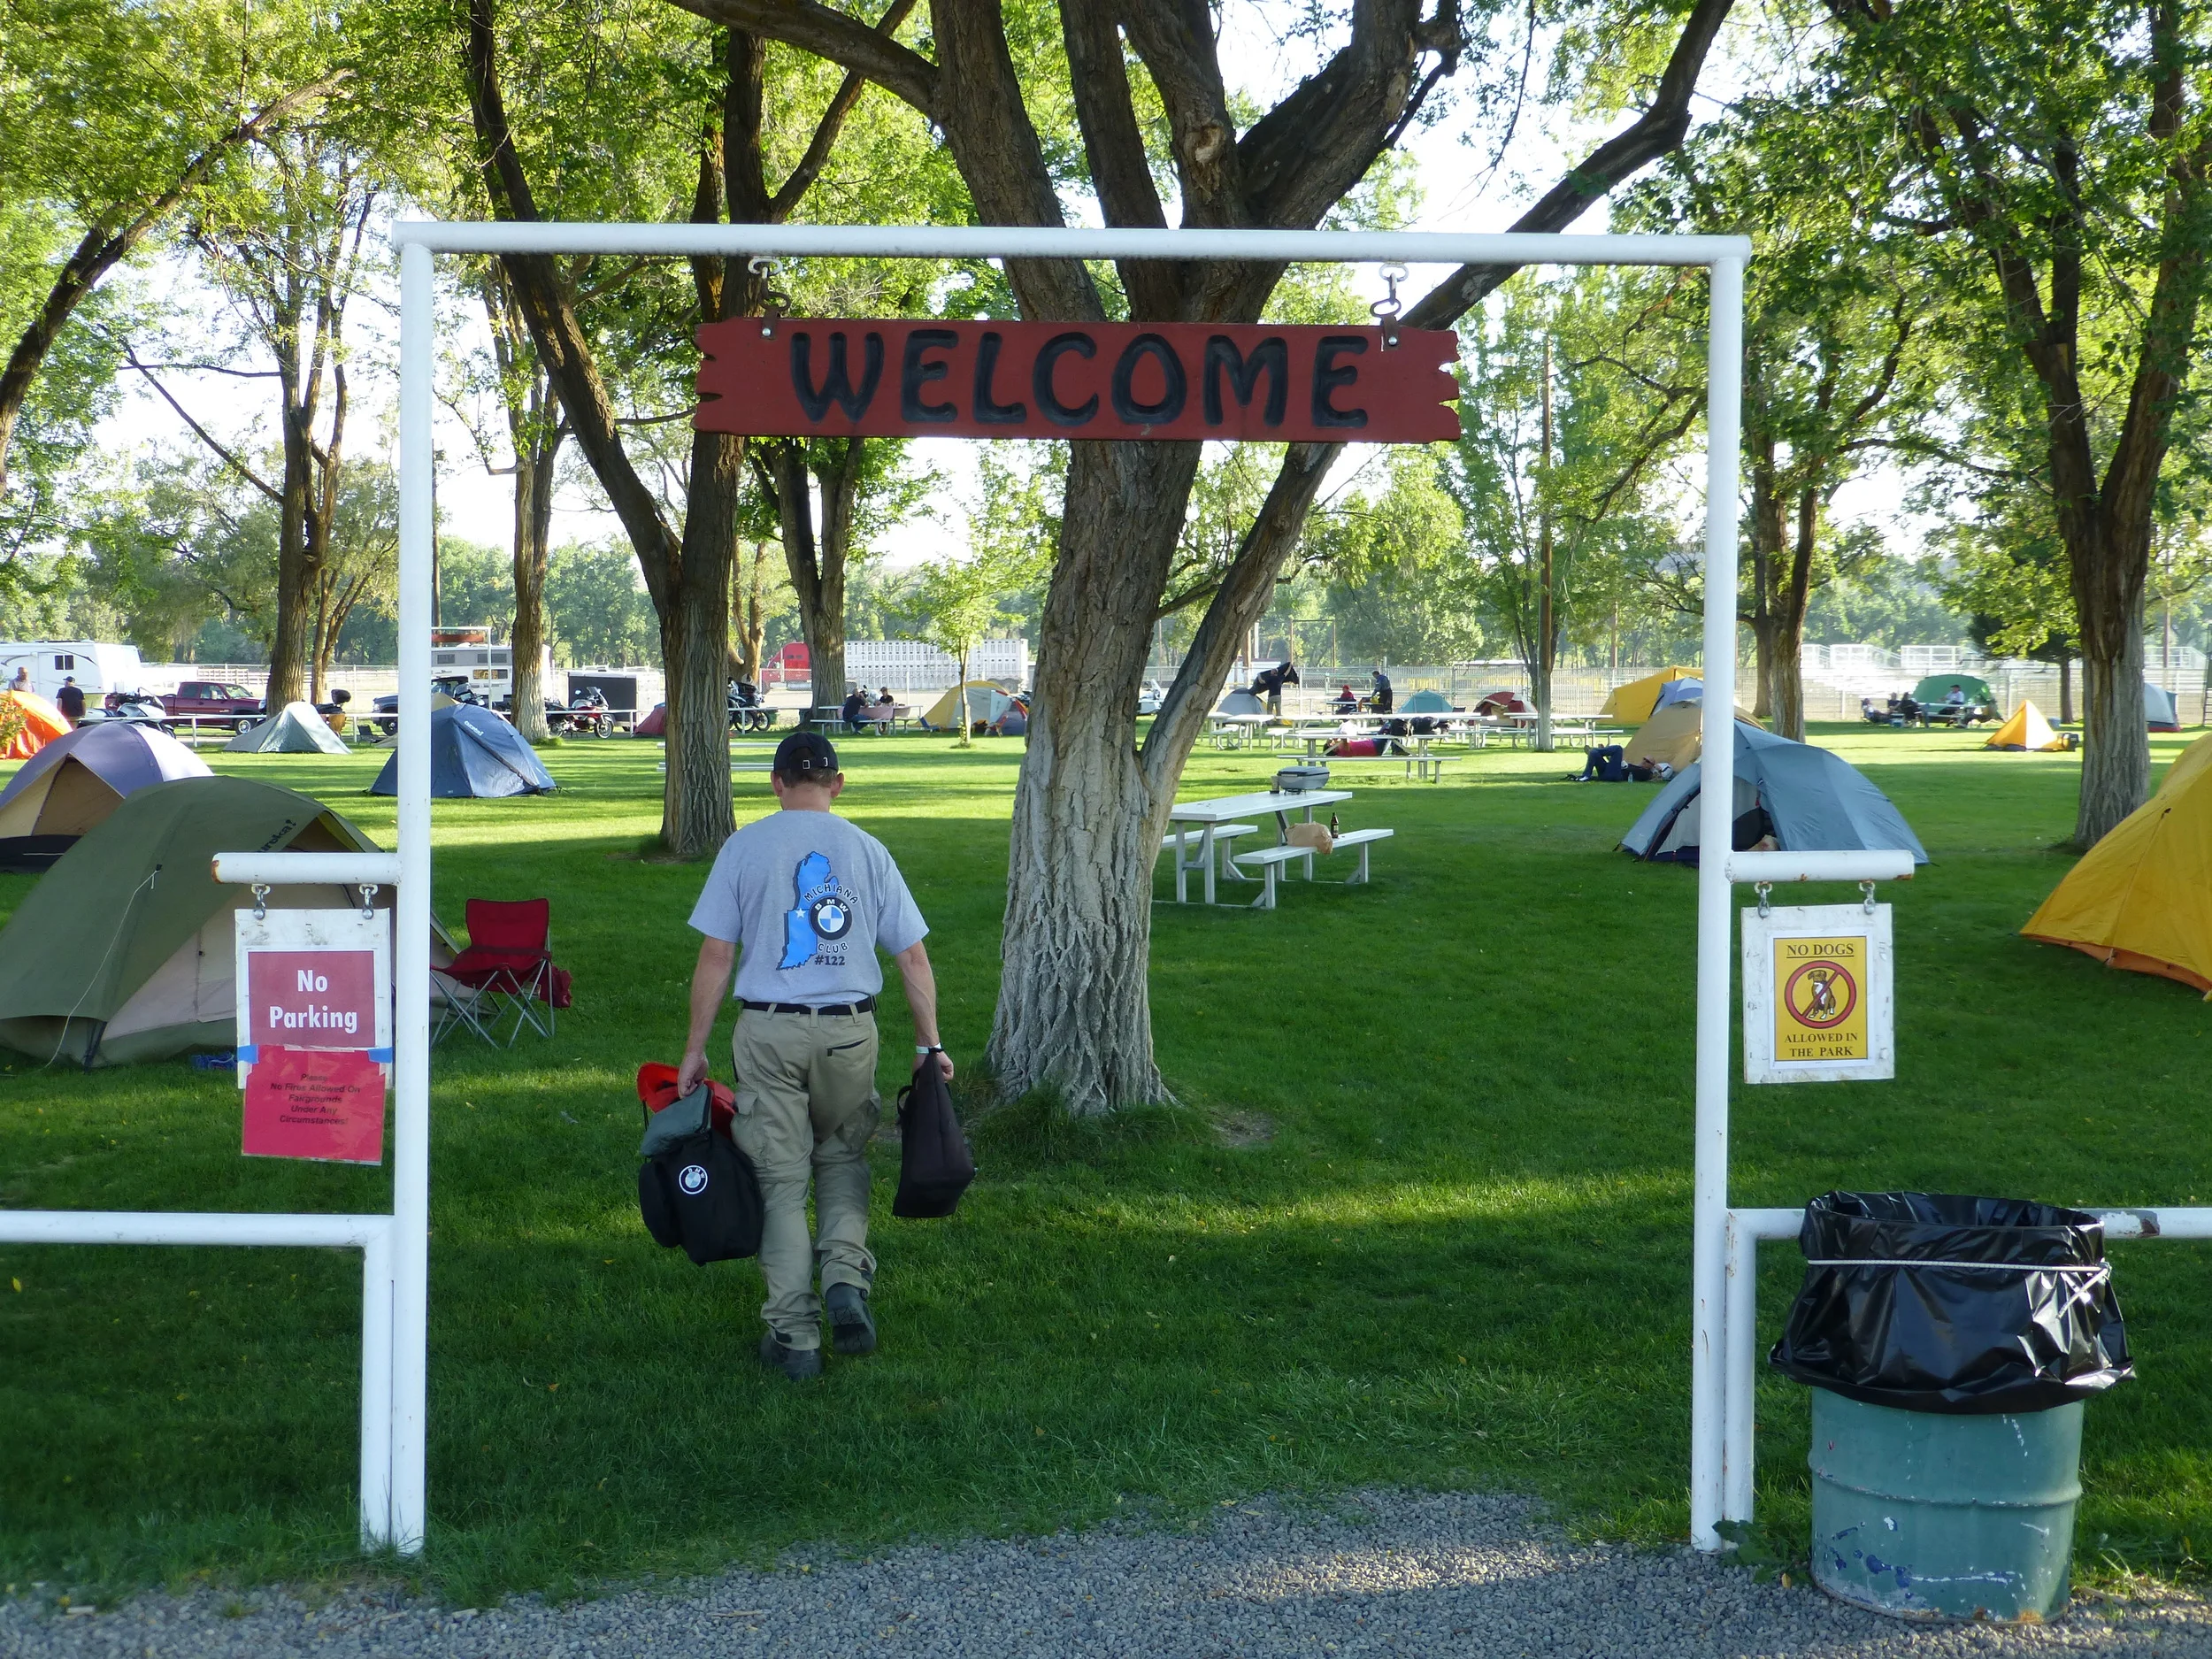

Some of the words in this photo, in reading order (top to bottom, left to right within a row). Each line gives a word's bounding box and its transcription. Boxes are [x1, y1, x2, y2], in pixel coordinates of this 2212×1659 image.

[789, 328, 1370, 429] WELCOME
[803, 883, 858, 904] MICHIANA
[814, 899, 849, 912] BMW
[818, 941, 849, 954] CLUB
[1786, 944, 1809, 956] NO
[1813, 943, 1855, 956] DOGS
[814, 955, 846, 966] #122
[297, 969, 328, 992] No
[269, 1005, 358, 1034] Parking
[1784, 1033, 1843, 1043] ALLOWED
[1846, 1033, 1858, 1041] IN
[1790, 1048, 1814, 1057] THE
[1819, 1046, 1854, 1056] PARK
[309, 1084, 344, 1093] Allowed
[288, 1094, 342, 1103] Fairgrounds
[319, 1106, 338, 1116] Any
